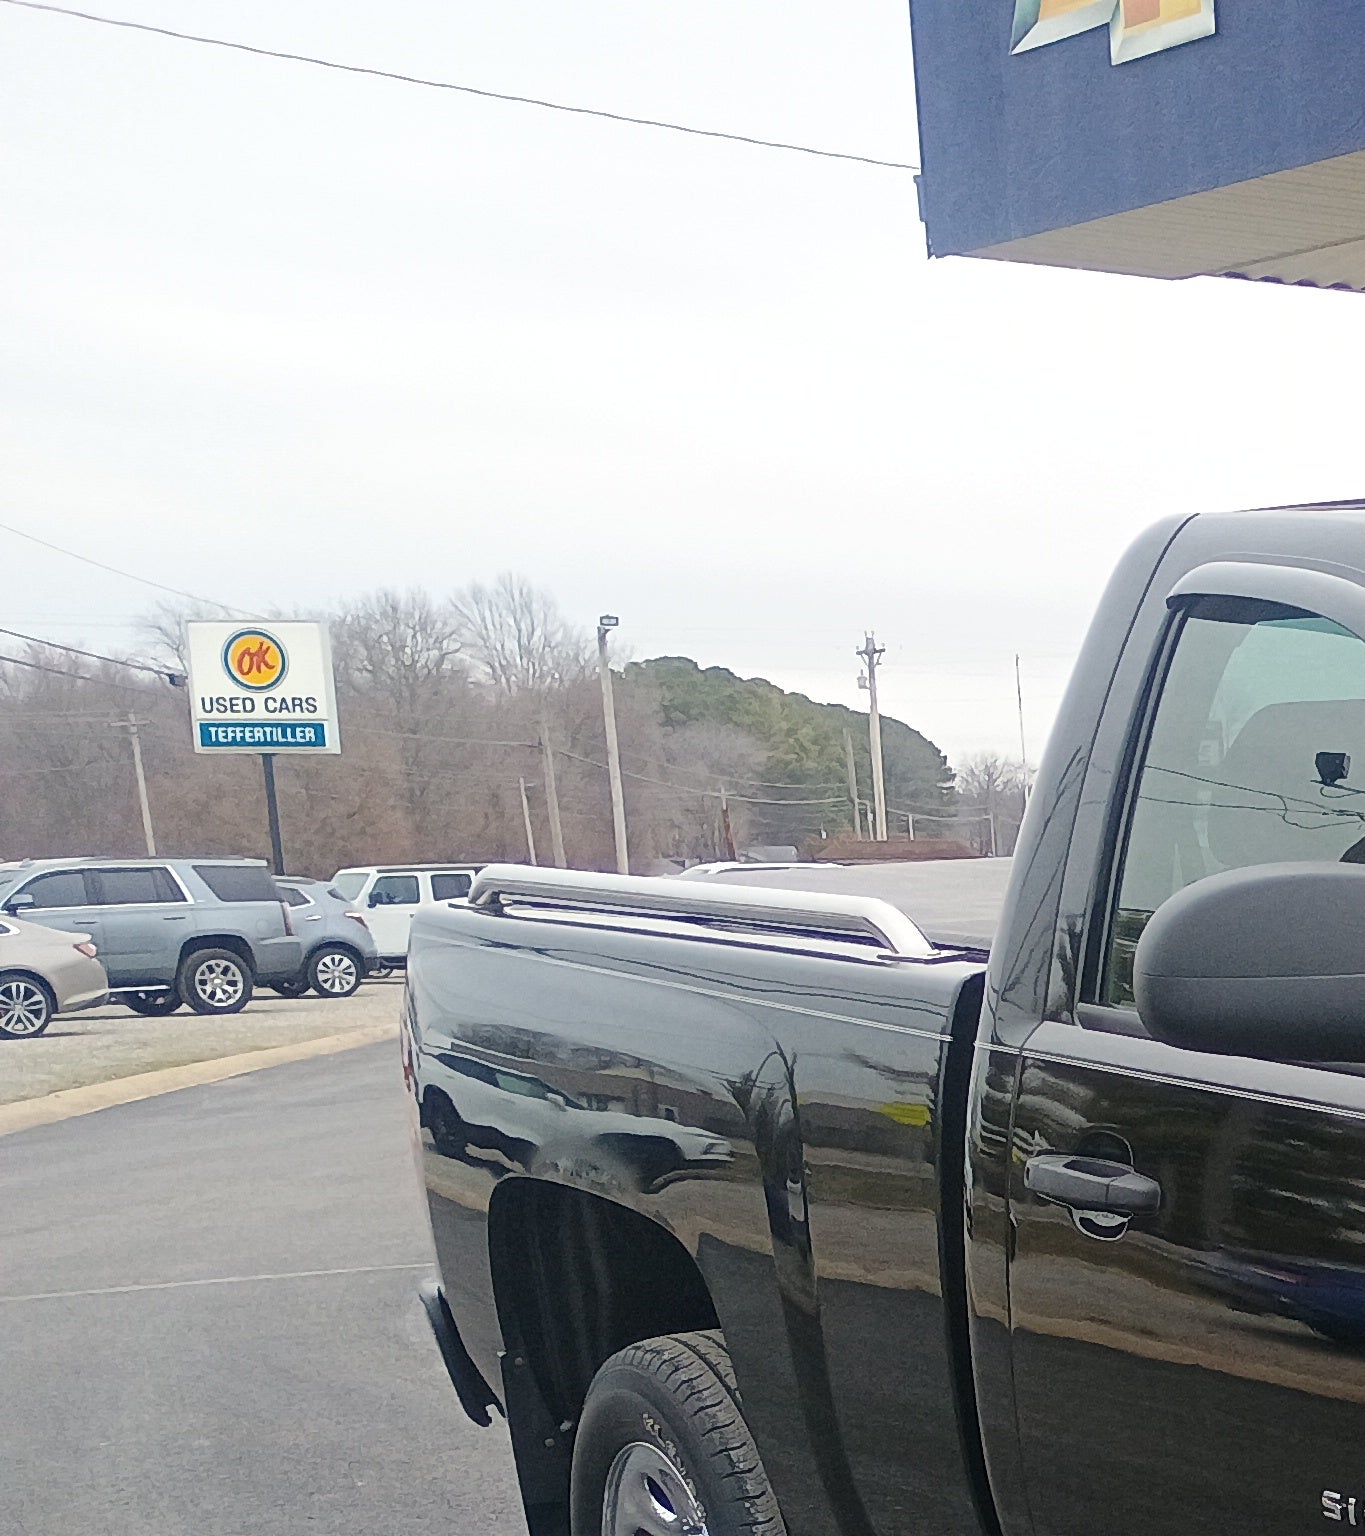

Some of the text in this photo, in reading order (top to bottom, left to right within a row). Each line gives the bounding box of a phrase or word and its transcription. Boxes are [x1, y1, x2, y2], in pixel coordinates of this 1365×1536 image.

[237, 641, 275, 676] OK
[201, 696, 318, 714] USED CARS
[208, 726, 317, 743] TEFFERTILLER
